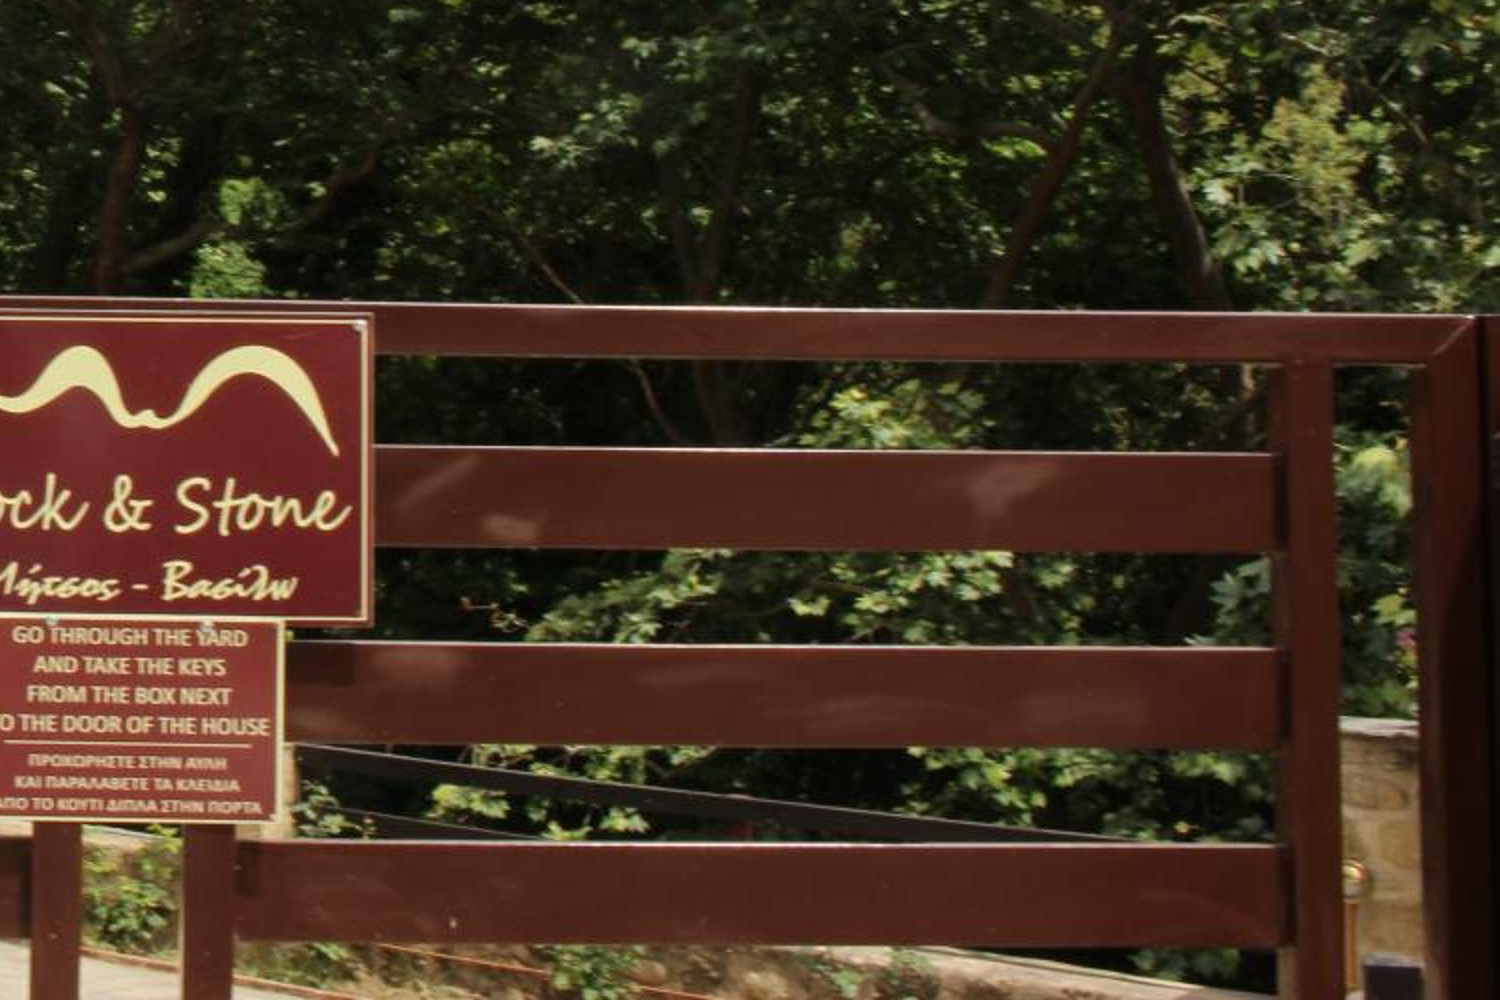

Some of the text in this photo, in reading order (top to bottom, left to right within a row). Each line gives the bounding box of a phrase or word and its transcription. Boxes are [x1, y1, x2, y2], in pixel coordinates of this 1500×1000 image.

[104, 474, 152, 532] &
[174, 476, 353, 536] Stone
[11, 625, 249, 647] GO THROUGH THE YARD
[33, 656, 227, 676] AND TAKE THE KEYS
[27, 685, 232, 706] FROM THE BOX NEXT
[21, 714, 58, 732] THE
[62, 715, 123, 734] DOOR
[125, 715, 154, 734] OF
[158, 717, 196, 735] THE
[201, 718, 270, 736] HOUSE
[14, 775, 42, 788] ΚΑΙ
[154, 778, 173, 792] ΤΑ
